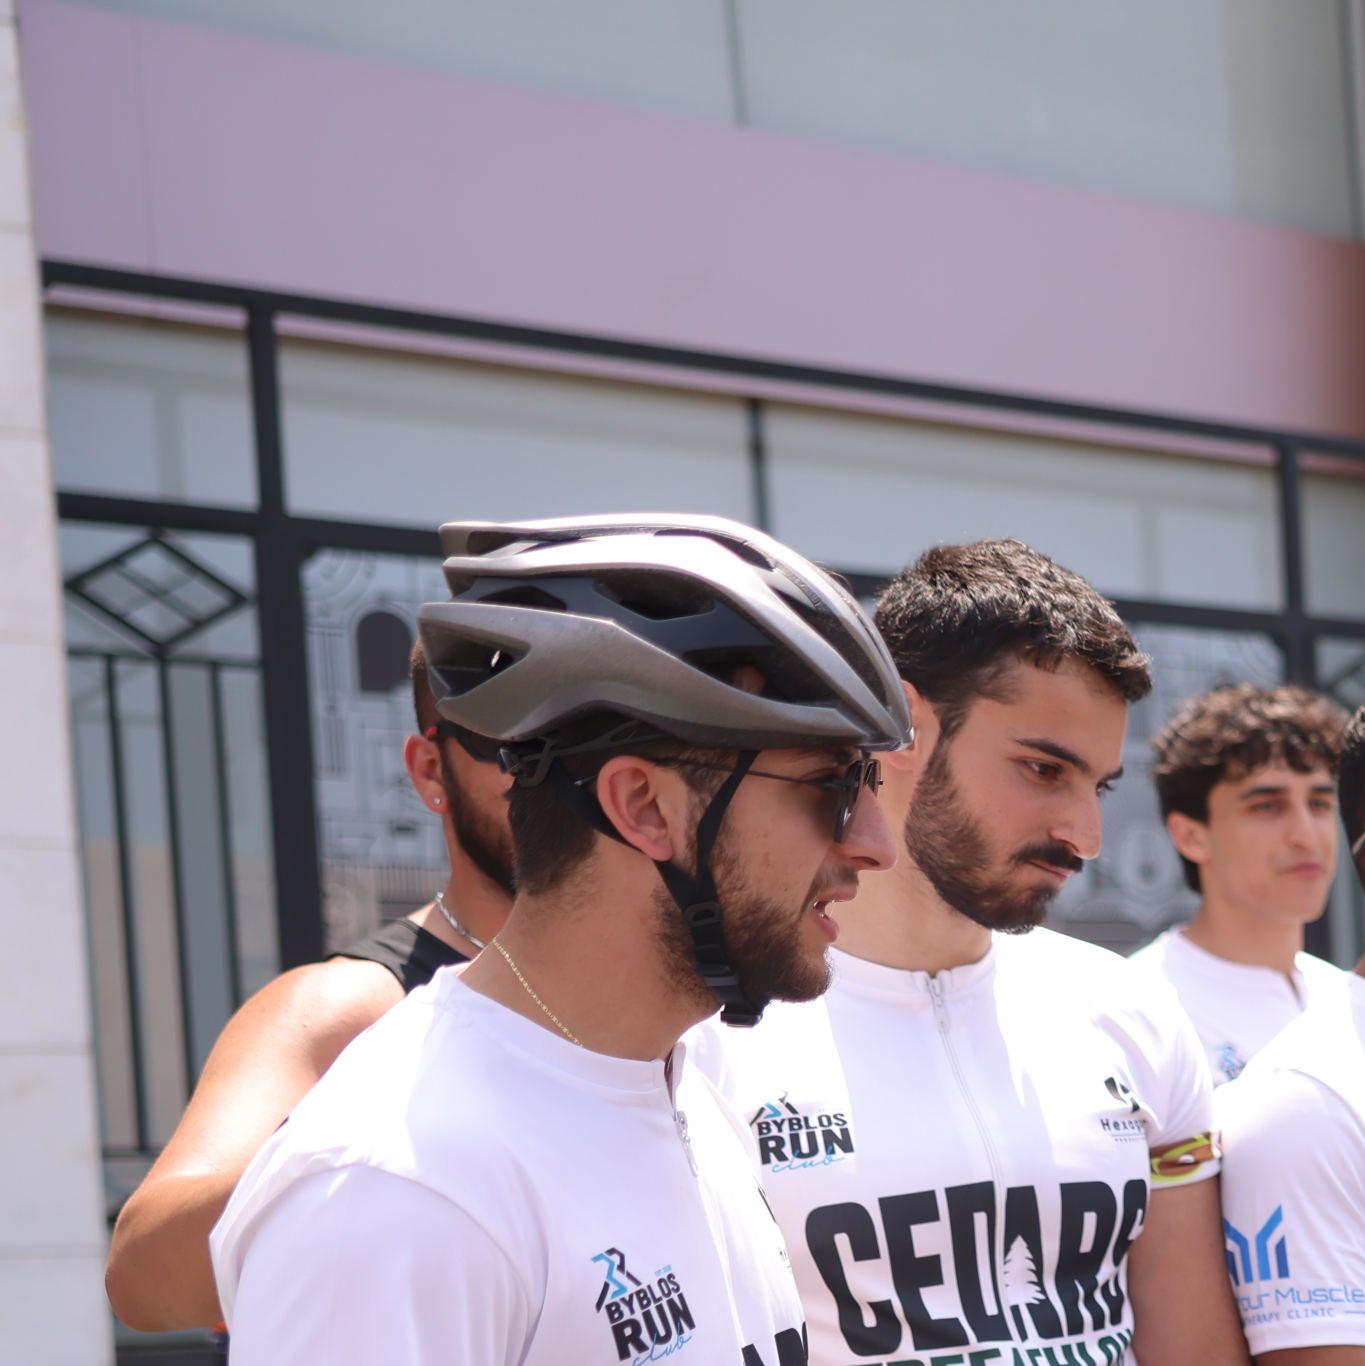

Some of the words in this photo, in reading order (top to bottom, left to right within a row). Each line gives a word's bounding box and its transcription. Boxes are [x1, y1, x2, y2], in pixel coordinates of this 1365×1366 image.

[757, 1113, 848, 1137] BYBLOS
[758, 1127, 855, 1166] RUN
[772, 1145, 846, 1173] club
[605, 1273, 681, 1325] BYBLOS
[1275, 1284, 1365, 1306] Muscle
[611, 1292, 696, 1362] RUN
[1287, 1307, 1336, 1320] CLINIC
